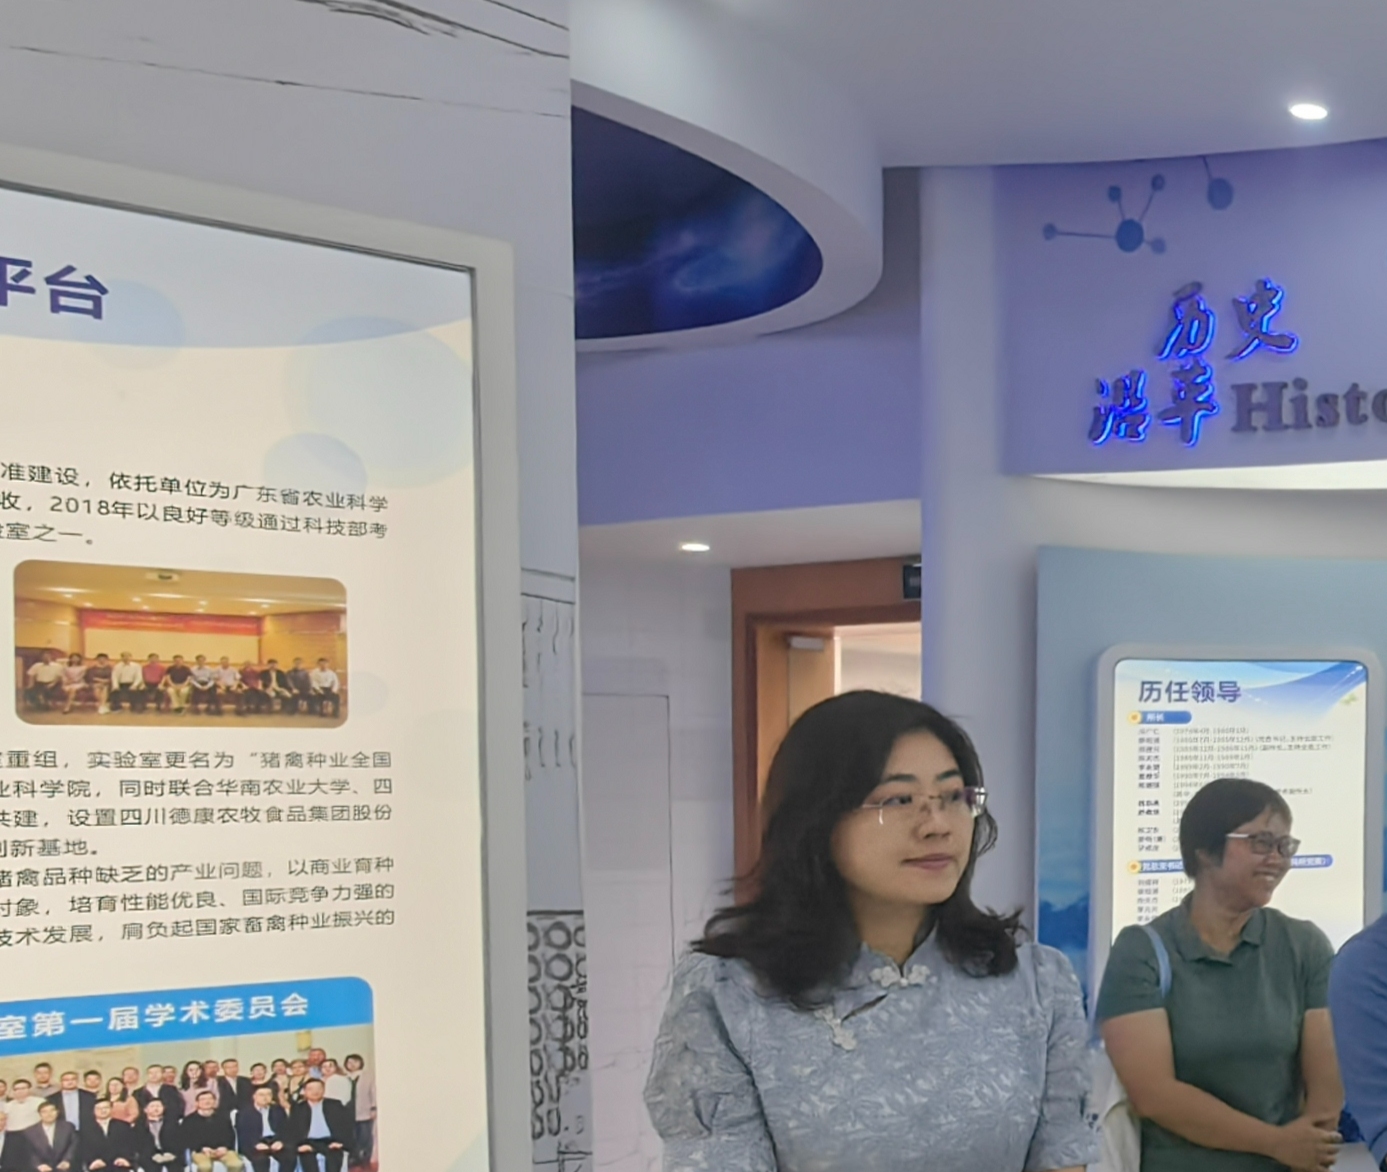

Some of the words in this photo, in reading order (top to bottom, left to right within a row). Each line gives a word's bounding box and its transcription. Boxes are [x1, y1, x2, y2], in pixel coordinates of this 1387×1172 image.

[1154, 279, 1299, 361] 历史
[1088, 361, 1220, 447] 沿革
[0, 522, 93, 545] 室之一。
[1138, 680, 1242, 704] 历任领导
[0, 750, 391, 769] 重组，实验室更名为“猪禽种业全国
[0, 838, 98, 858] 新基地。
[0, 992, 309, 1040] 室第一届学术委员会
